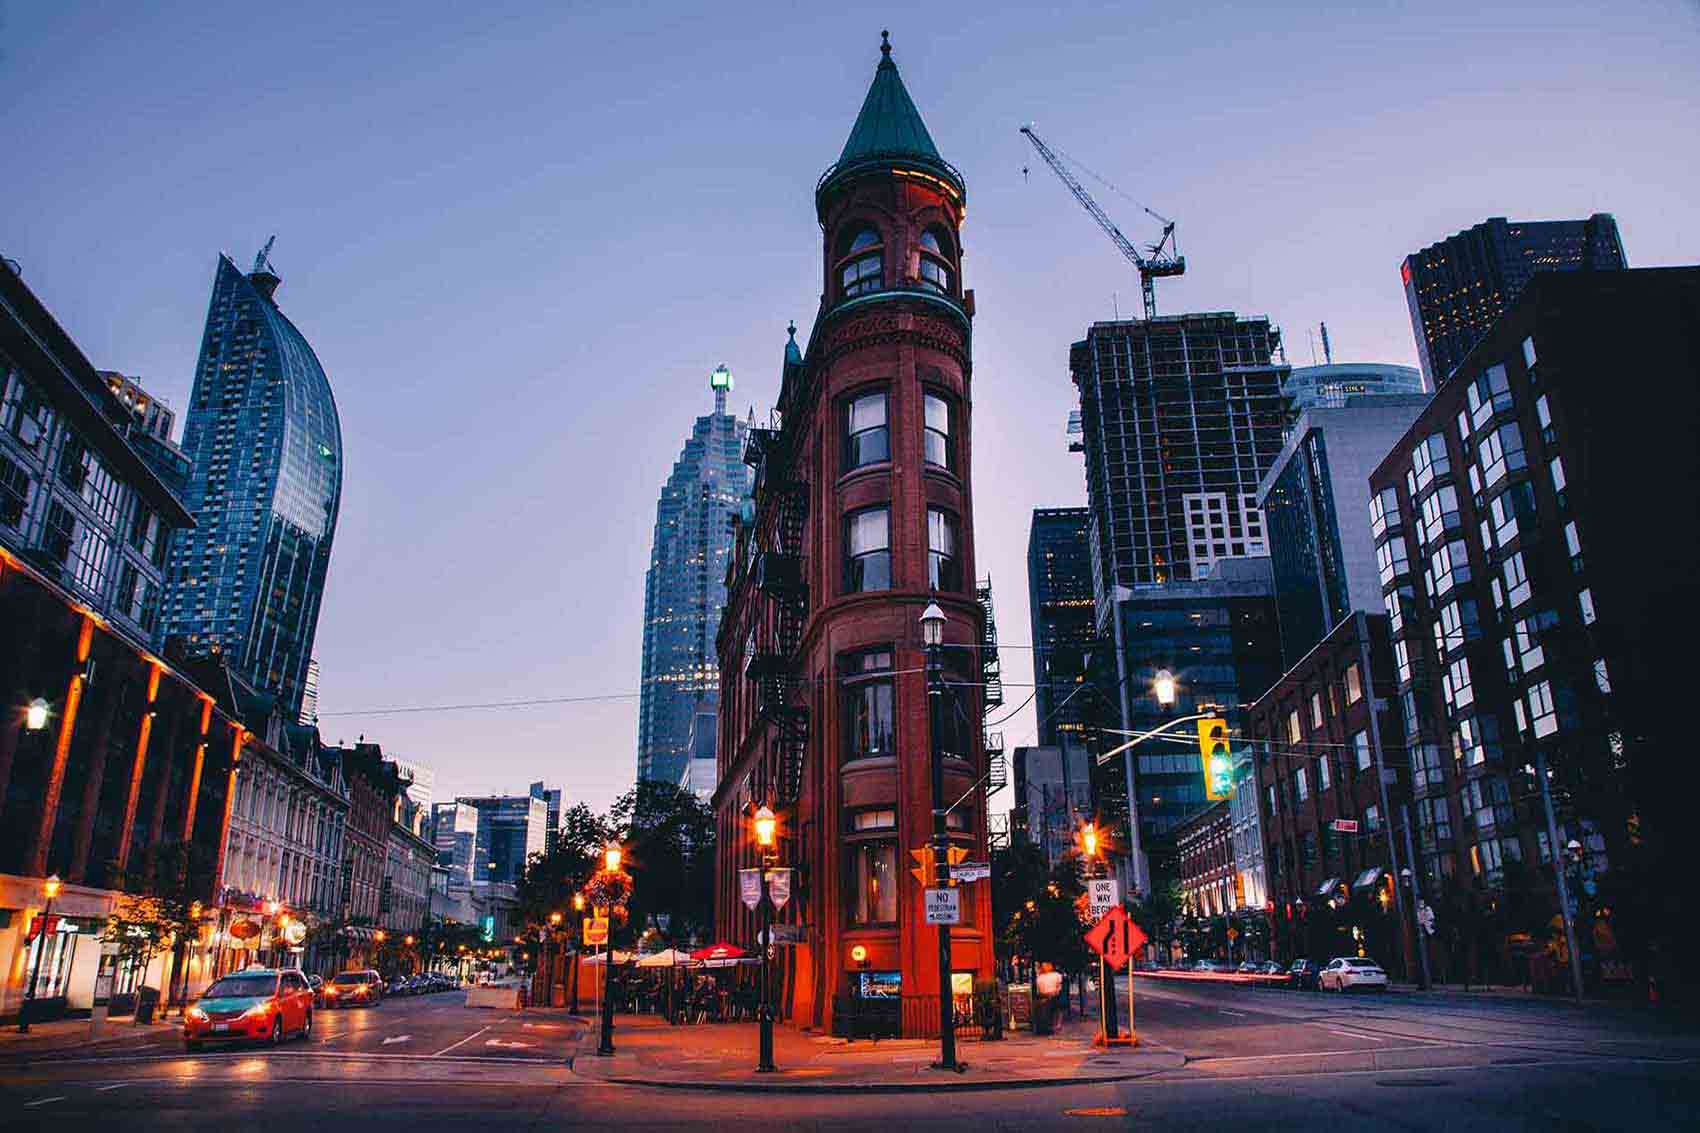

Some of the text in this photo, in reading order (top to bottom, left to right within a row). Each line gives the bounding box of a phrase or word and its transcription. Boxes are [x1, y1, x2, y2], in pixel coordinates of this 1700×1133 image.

[1095, 883, 1110, 892] ONE
[936, 892, 949, 903] NO
[1096, 894, 1111, 902] WAY
